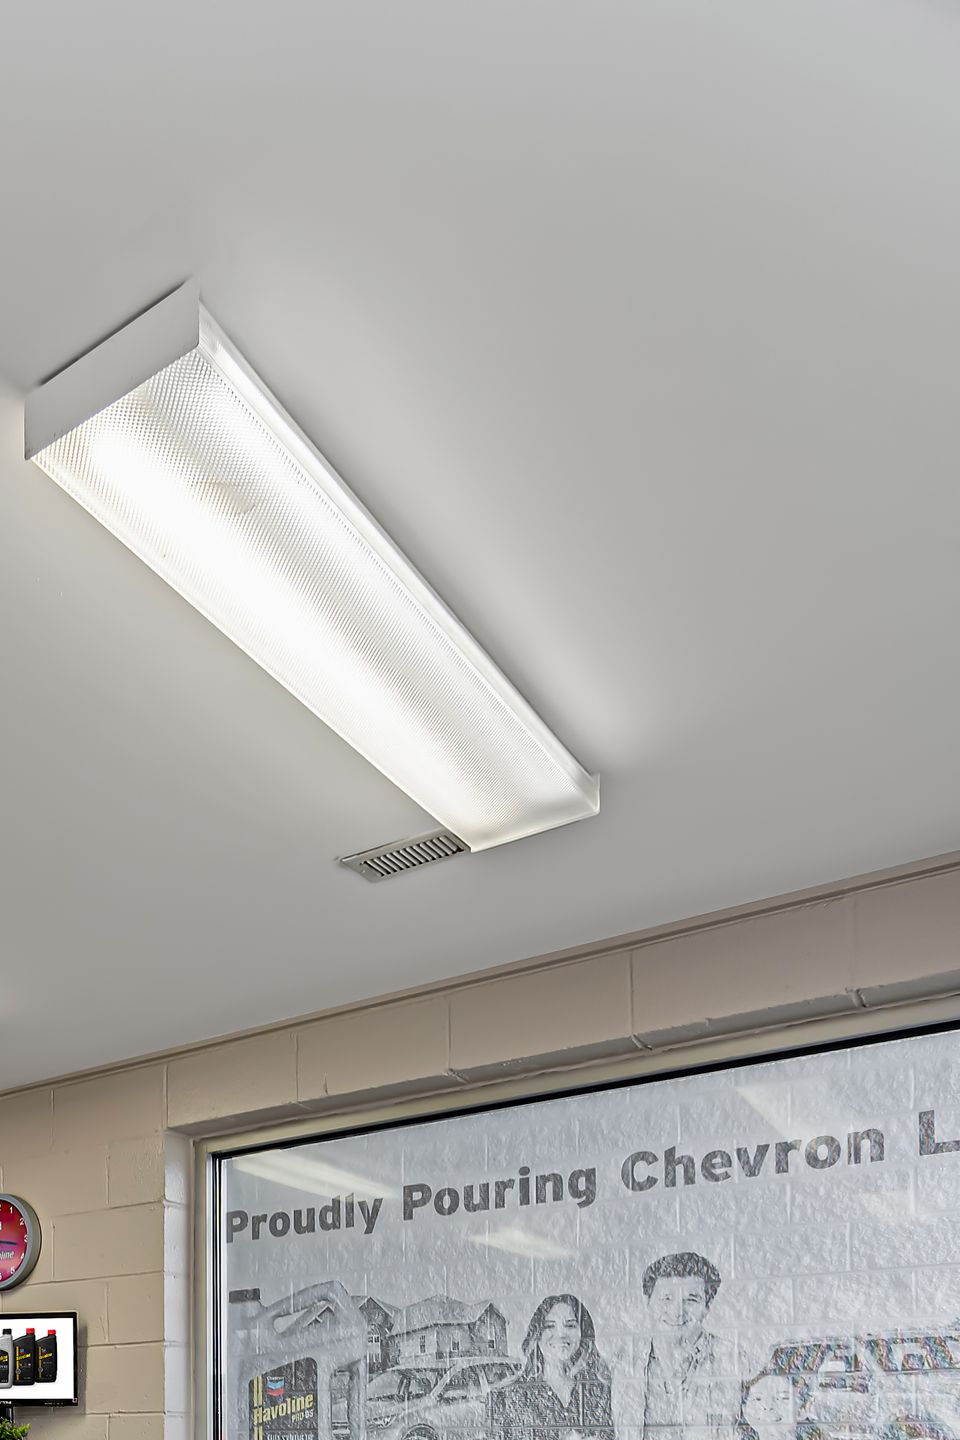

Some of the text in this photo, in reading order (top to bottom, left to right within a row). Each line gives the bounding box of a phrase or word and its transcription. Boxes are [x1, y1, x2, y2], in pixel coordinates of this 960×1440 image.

[226, 1193, 384, 1243] Proudly
[402, 1166, 597, 1221] Pouring
[620, 1128, 885, 1192] Chevron
[9, 1206, 13, 1214] 1
[19, 1217, 25, 1226] 2
[252, 1393, 314, 1426] Havoline
